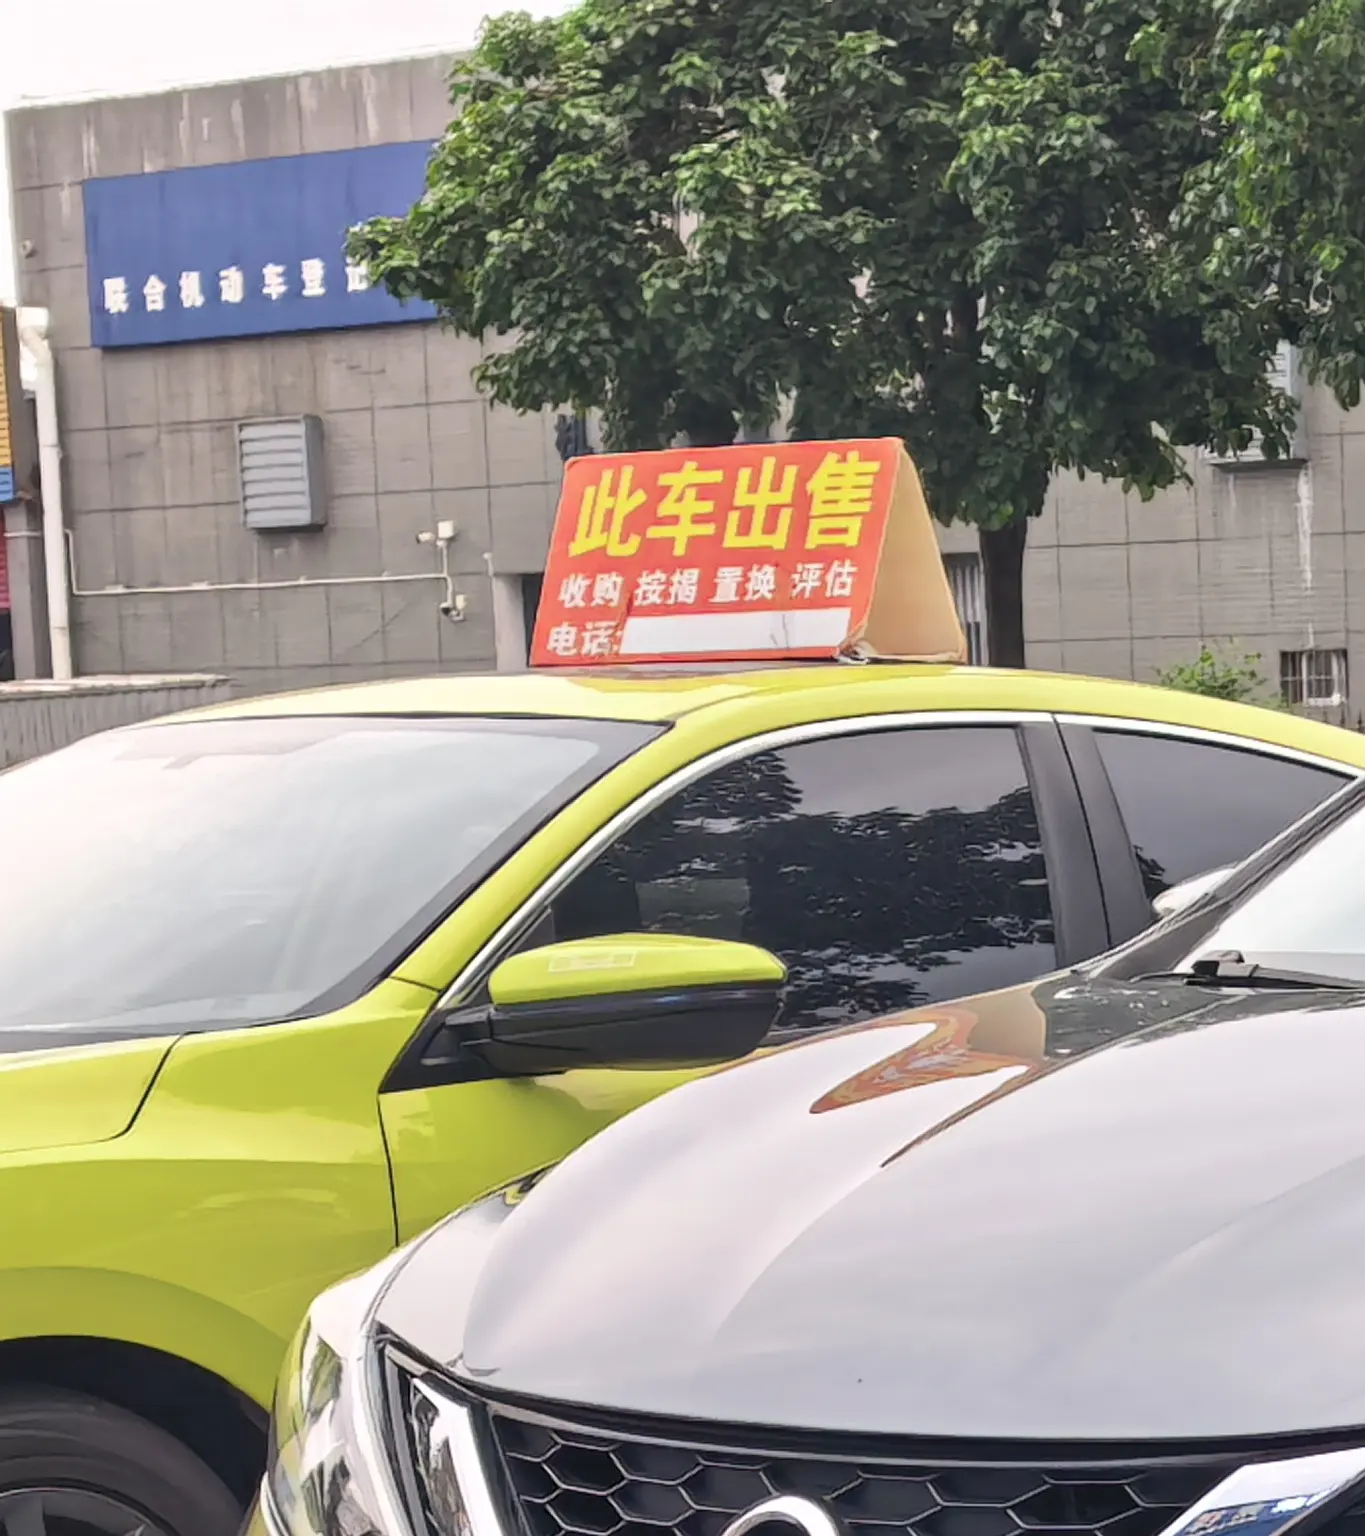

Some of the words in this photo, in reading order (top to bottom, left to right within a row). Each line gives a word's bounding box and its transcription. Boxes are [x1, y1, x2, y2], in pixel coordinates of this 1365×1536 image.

[568, 450, 881, 557] 此车出售
[558, 571, 625, 608] 收购
[634, 567, 701, 606] 按揭
[708, 564, 778, 603] 置换
[791, 559, 859, 598] 评估
